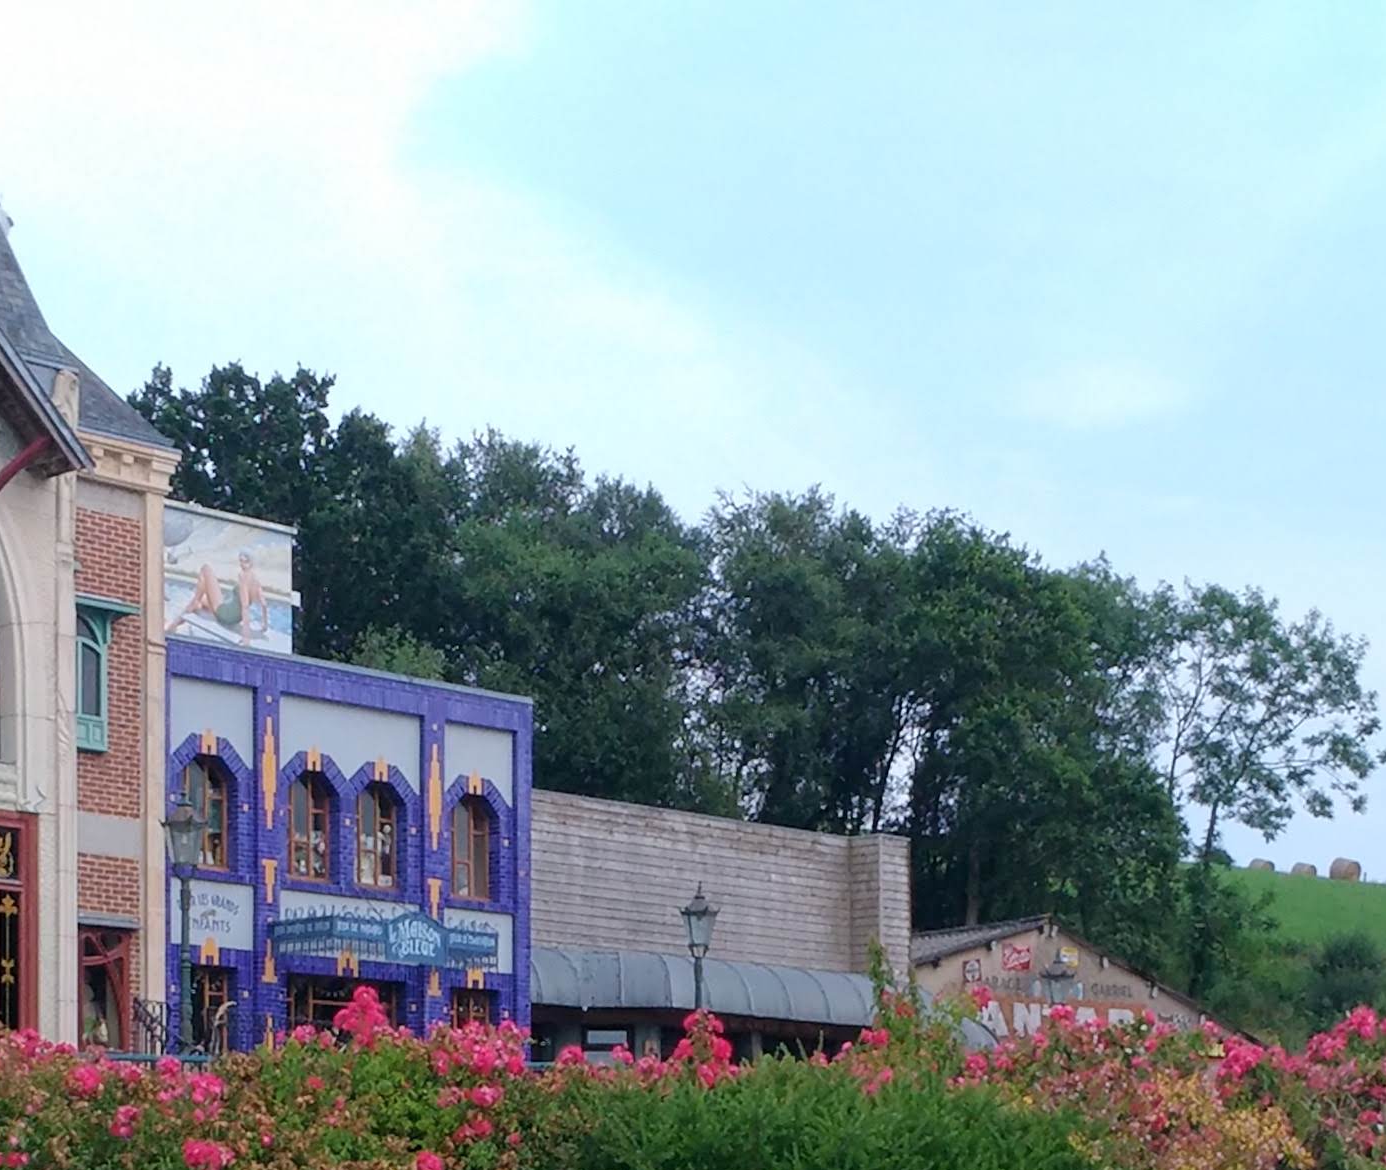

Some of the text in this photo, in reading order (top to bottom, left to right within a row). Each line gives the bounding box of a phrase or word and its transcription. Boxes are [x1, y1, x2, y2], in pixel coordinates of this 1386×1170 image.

[192, 917, 231, 933] NFANTS
[397, 919, 441, 948] MAISON
[982, 975, 1022, 992] ARAGE
